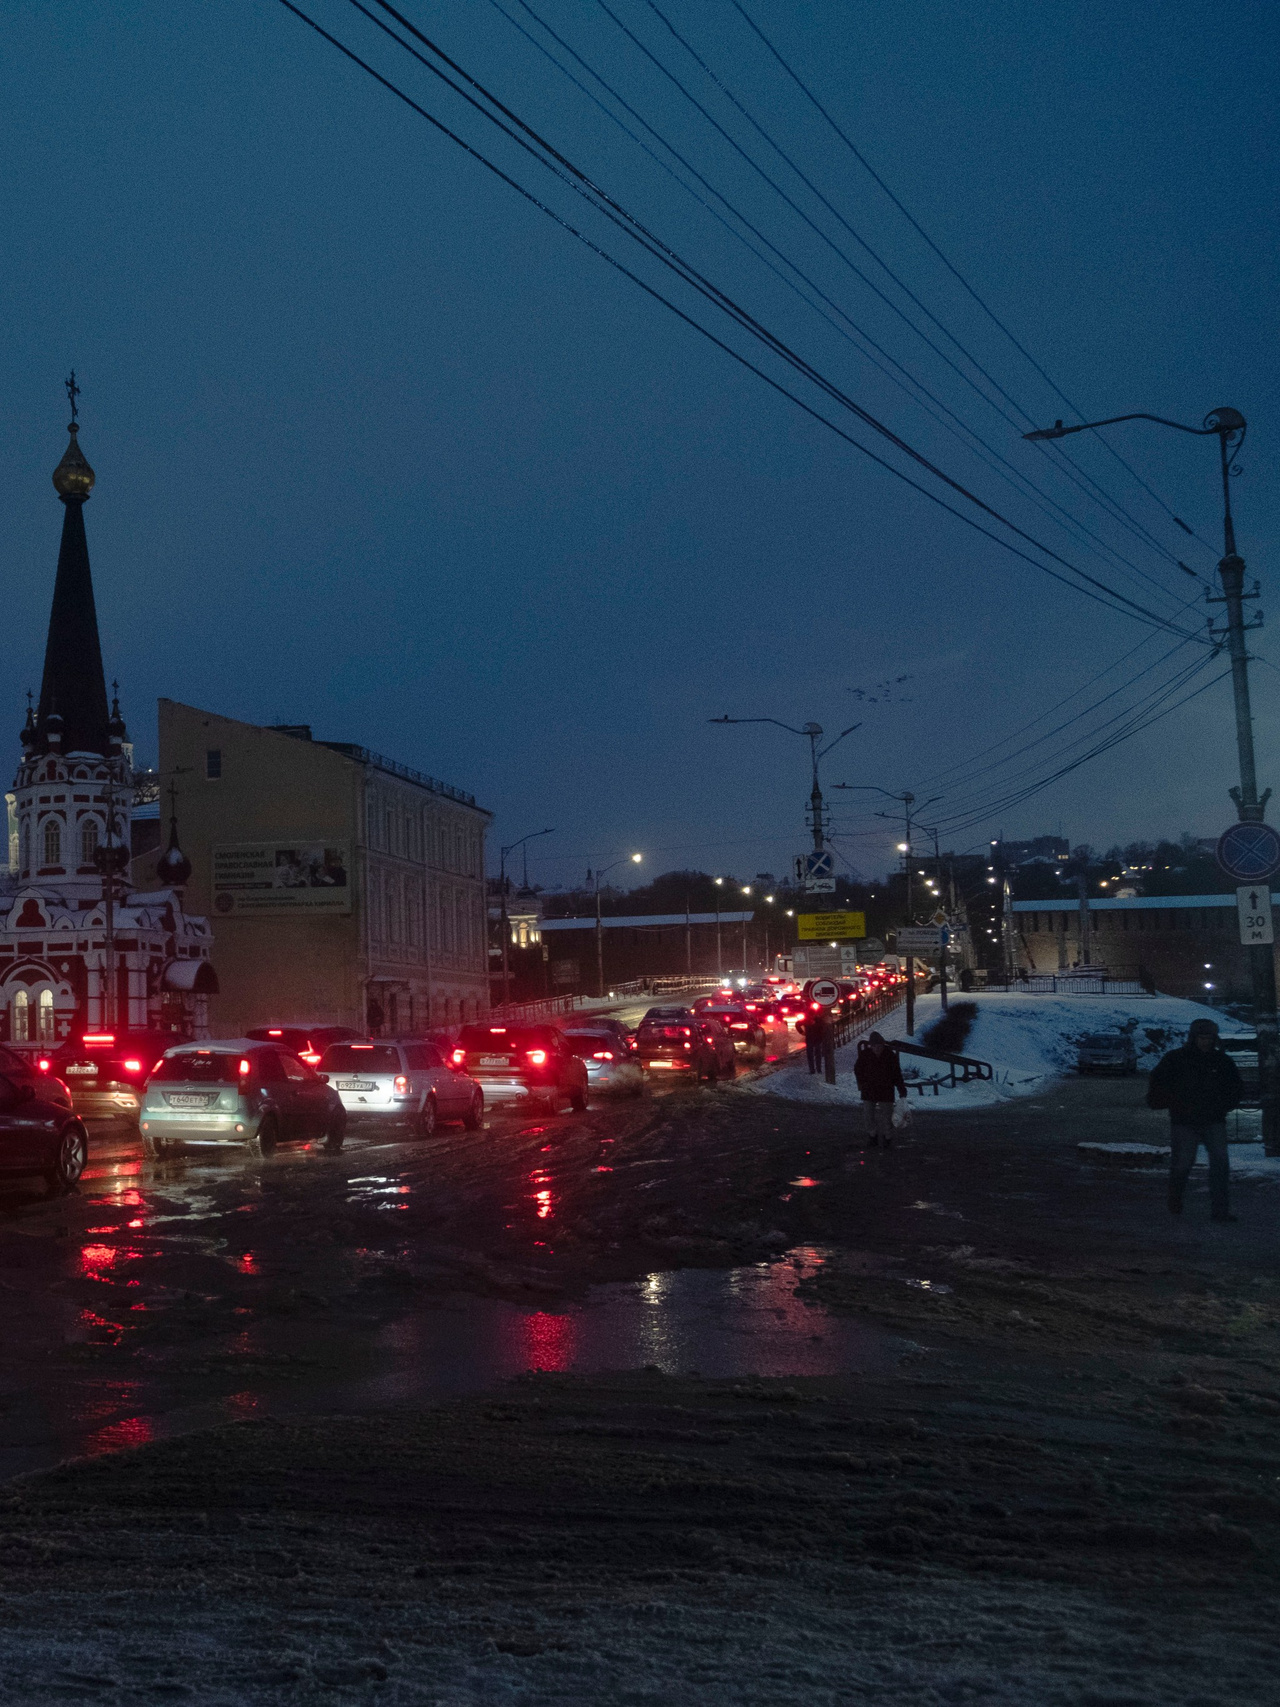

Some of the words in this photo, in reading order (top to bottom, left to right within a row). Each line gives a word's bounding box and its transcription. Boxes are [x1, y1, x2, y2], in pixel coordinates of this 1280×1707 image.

[215, 851, 265, 860] СМОЛЕНСКАЯ
[215, 860, 273, 869] ПРАВОСЛАВНАЯ
[1246, 916, 1265, 928] 30
